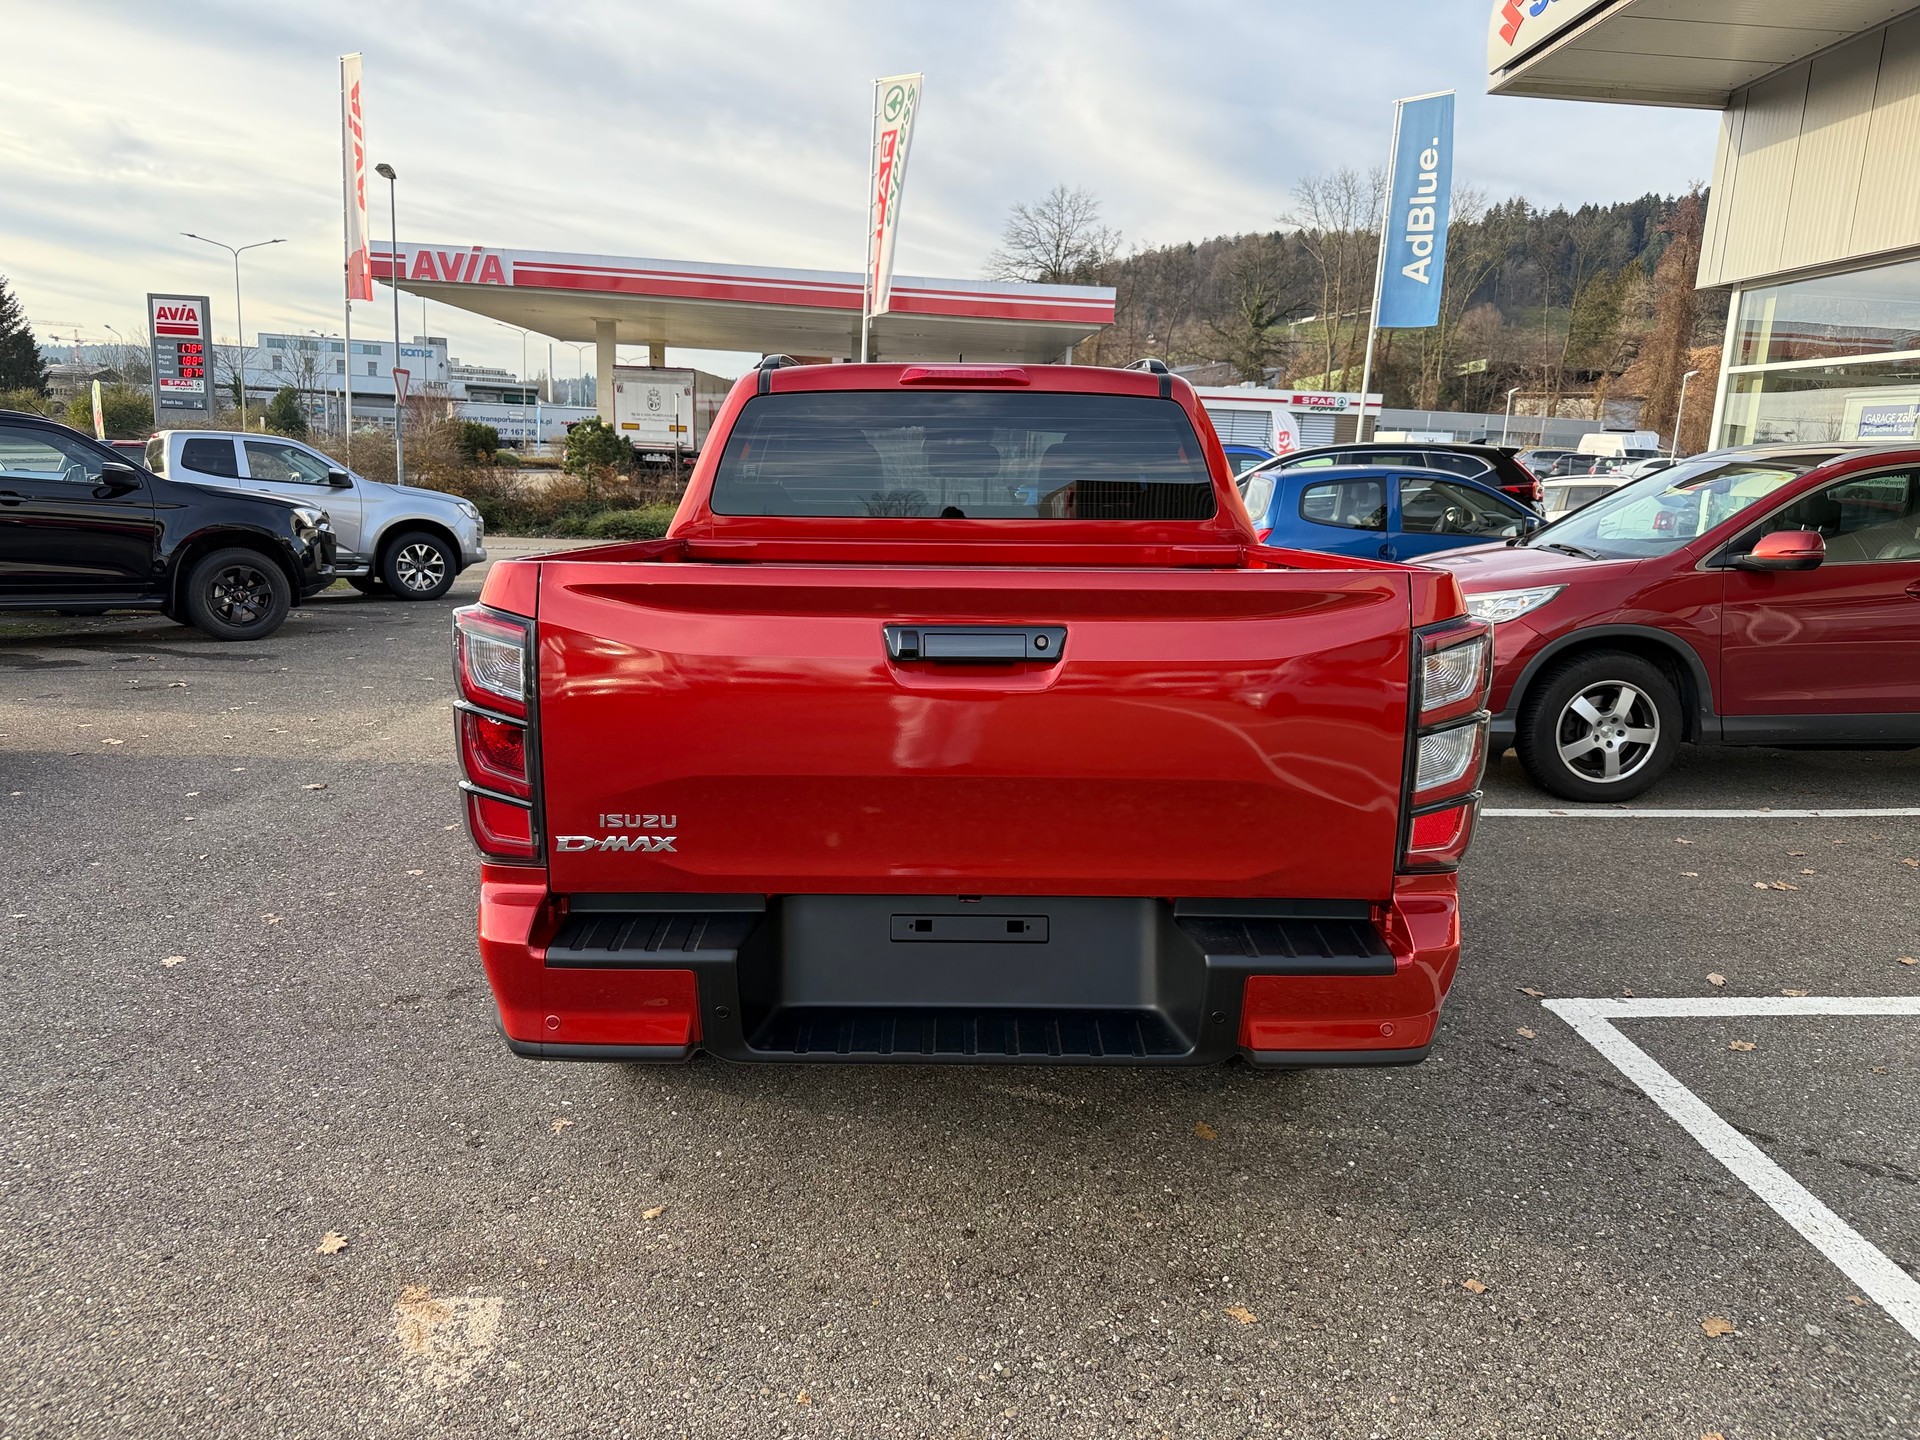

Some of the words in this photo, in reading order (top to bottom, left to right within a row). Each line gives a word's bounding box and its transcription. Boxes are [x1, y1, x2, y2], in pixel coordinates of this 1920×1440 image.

[886, 83, 916, 228] express
[1402, 136, 1438, 285] AdBlue.
[411, 246, 507, 285] AVIA
[156, 305, 198, 321] AVIA
[1301, 396, 1335, 405] SPAR
[1865, 413, 1896, 423] GARAGE
[599, 804, 677, 829] ISUZU
[555, 835, 678, 852] D-MAX
